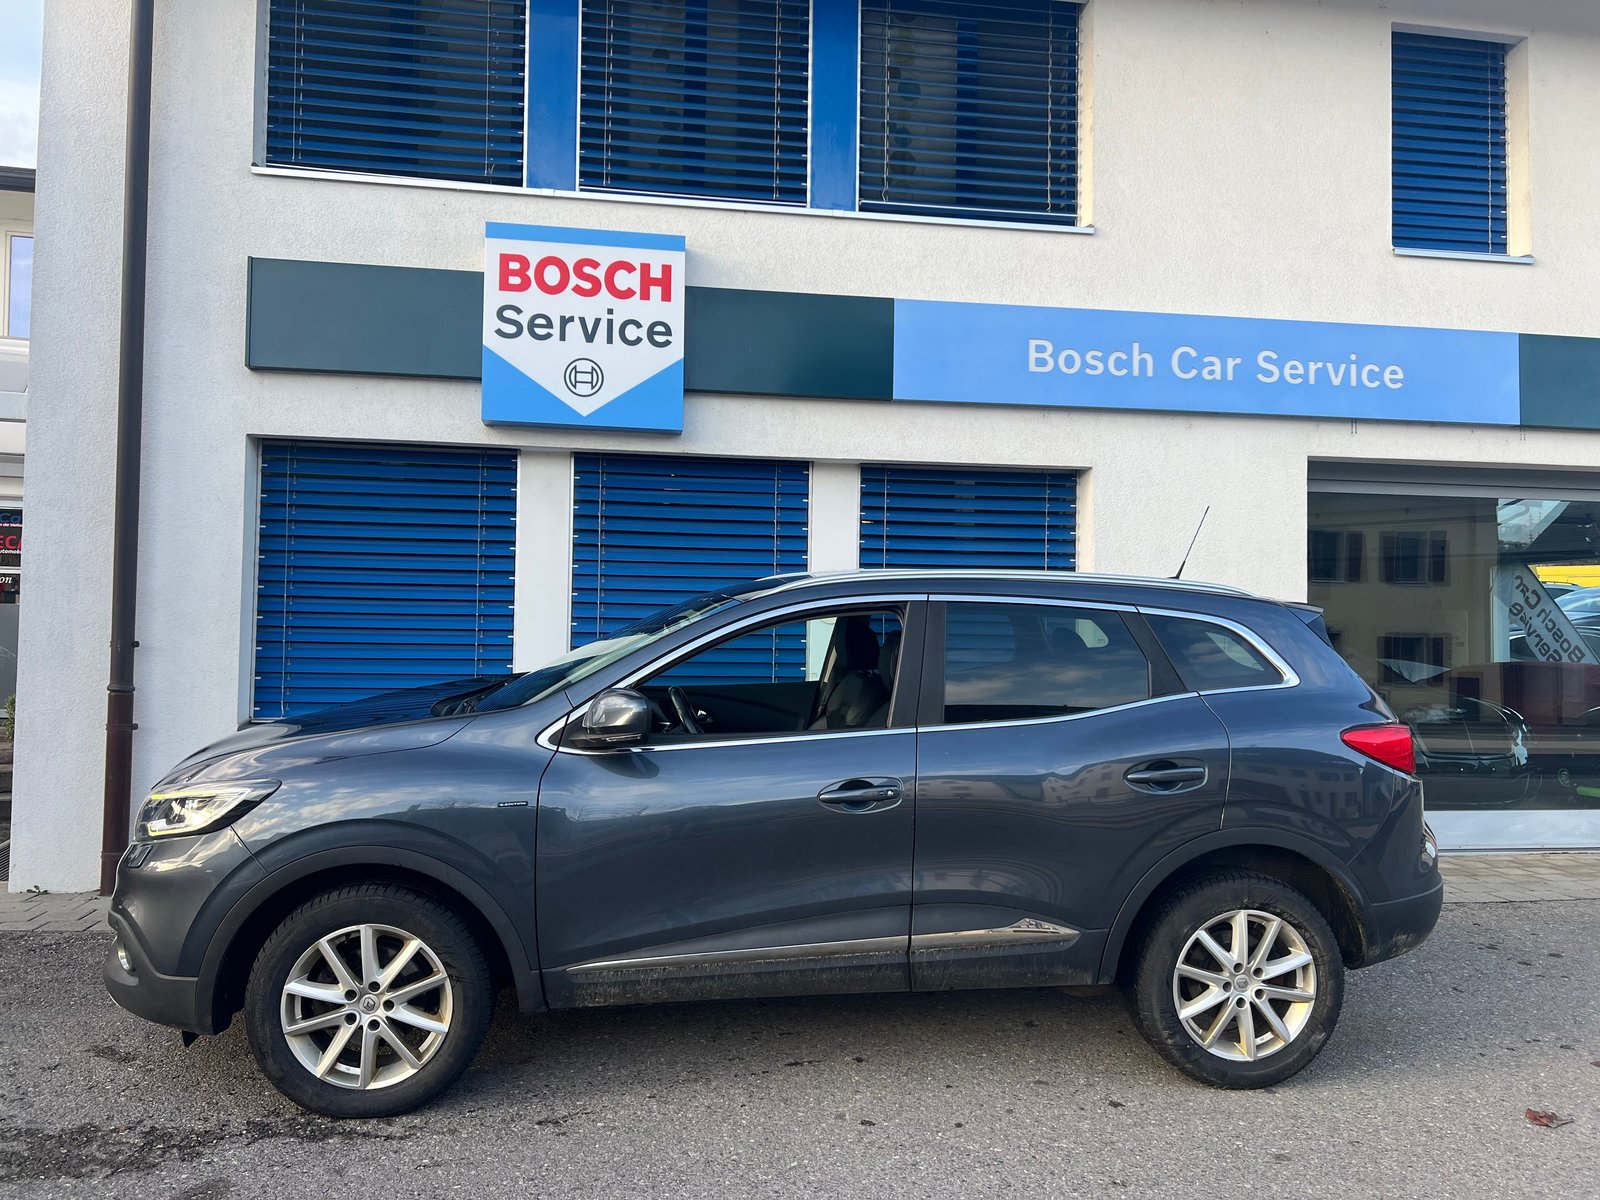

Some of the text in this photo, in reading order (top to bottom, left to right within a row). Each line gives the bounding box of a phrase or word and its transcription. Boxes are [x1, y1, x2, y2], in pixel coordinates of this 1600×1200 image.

[498, 253, 672, 302] BOSCH
[494, 304, 672, 348] Service
[1027, 338, 1404, 389] Bosch Car Service
